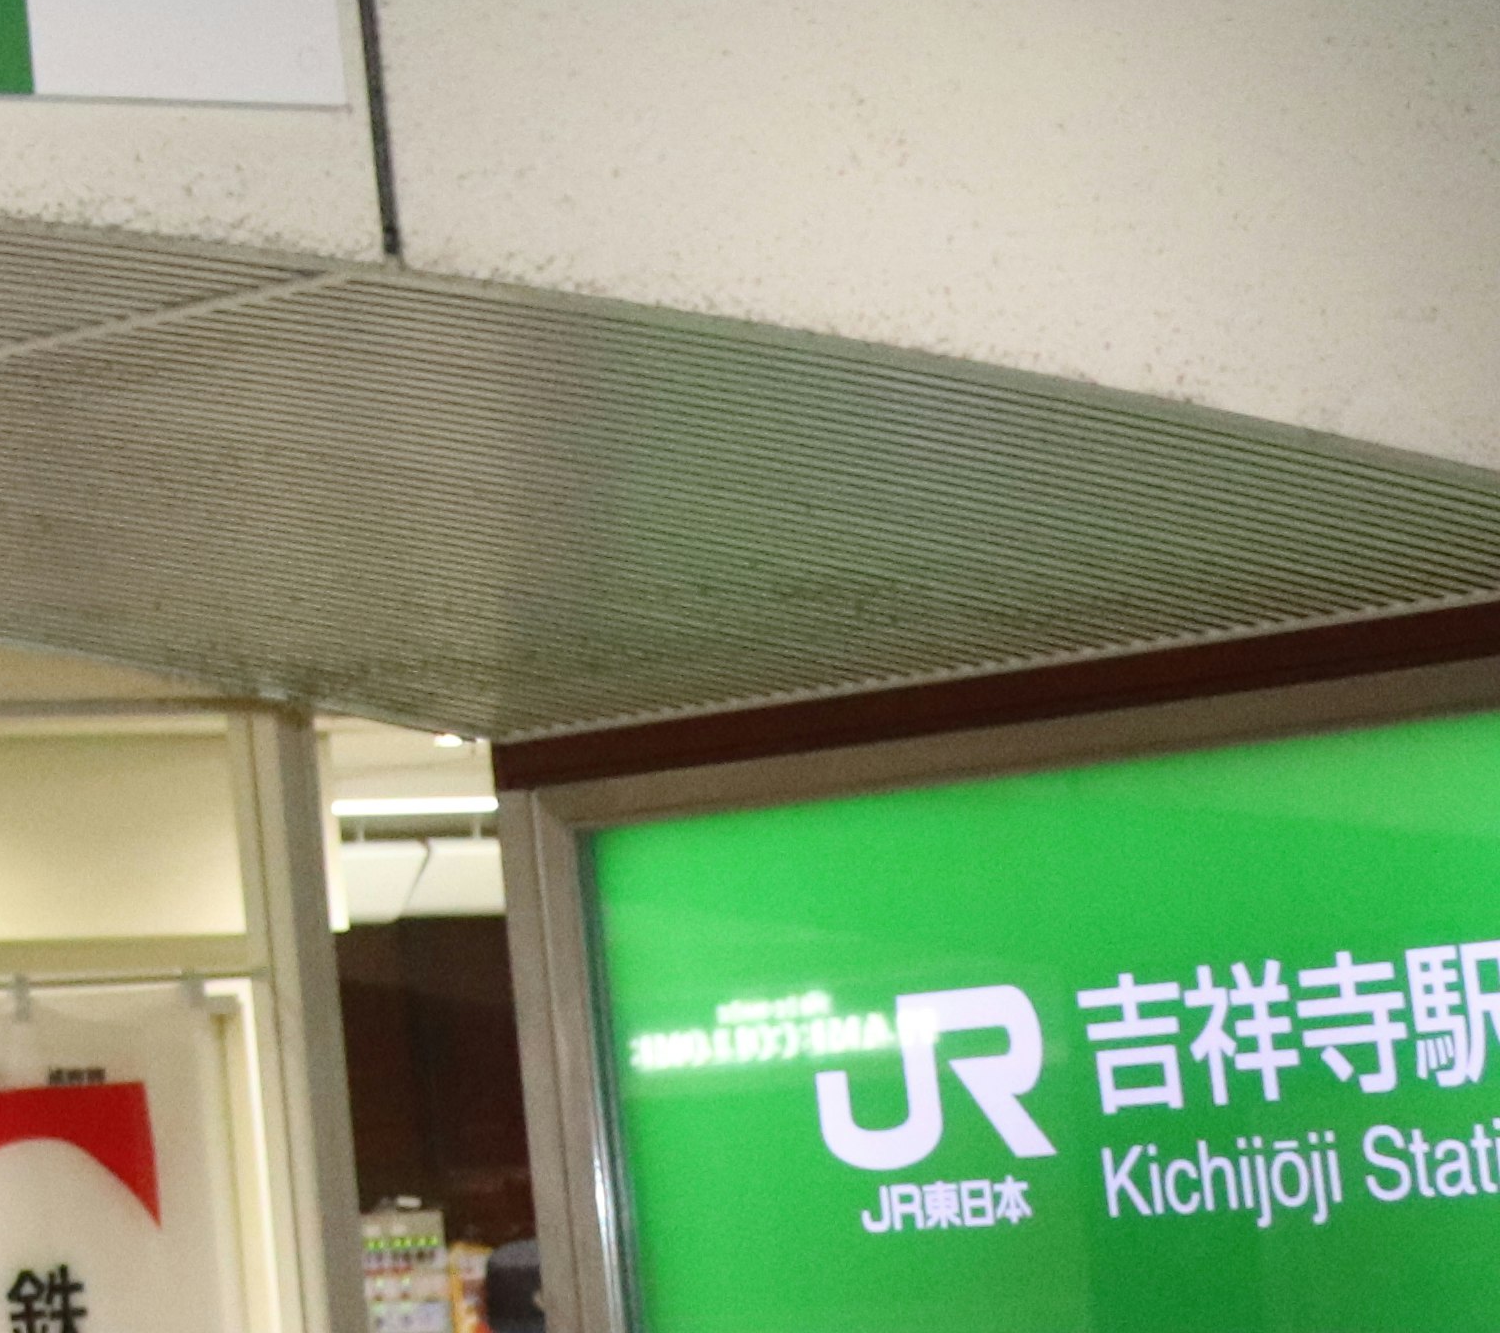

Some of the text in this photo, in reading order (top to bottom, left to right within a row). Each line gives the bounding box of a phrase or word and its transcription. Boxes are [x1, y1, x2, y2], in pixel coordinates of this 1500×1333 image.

[815, 985, 1057, 1170] JR
[1076, 938, 1500, 1115] 吉祥寺駅
[861, 1175, 1032, 1233] JR東日本
[1101, 1130, 1342, 1228] Kichijōji
